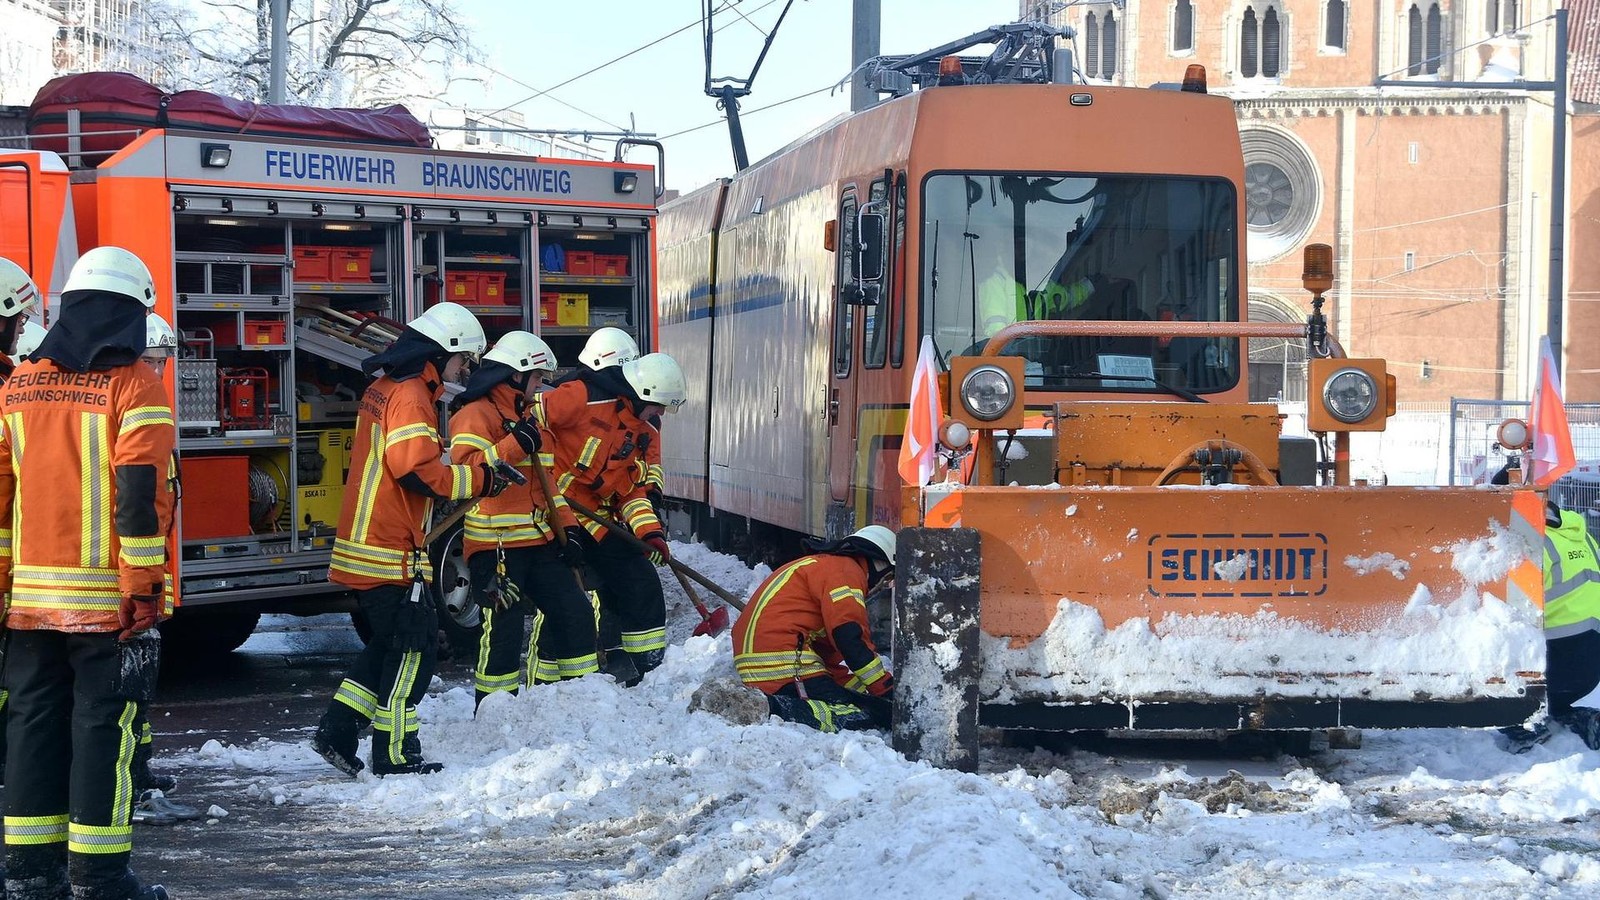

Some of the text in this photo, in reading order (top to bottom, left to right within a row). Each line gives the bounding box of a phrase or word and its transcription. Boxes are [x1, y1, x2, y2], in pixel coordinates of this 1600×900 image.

[266, 150, 571, 194] FEUERWEHR BRAUNSCHWEIG
[8, 372, 111, 390] FEUERWEHR
[5, 389, 107, 406] BRAUNSCHWEIG
[1162, 548, 1316, 580] SCHMIDT
